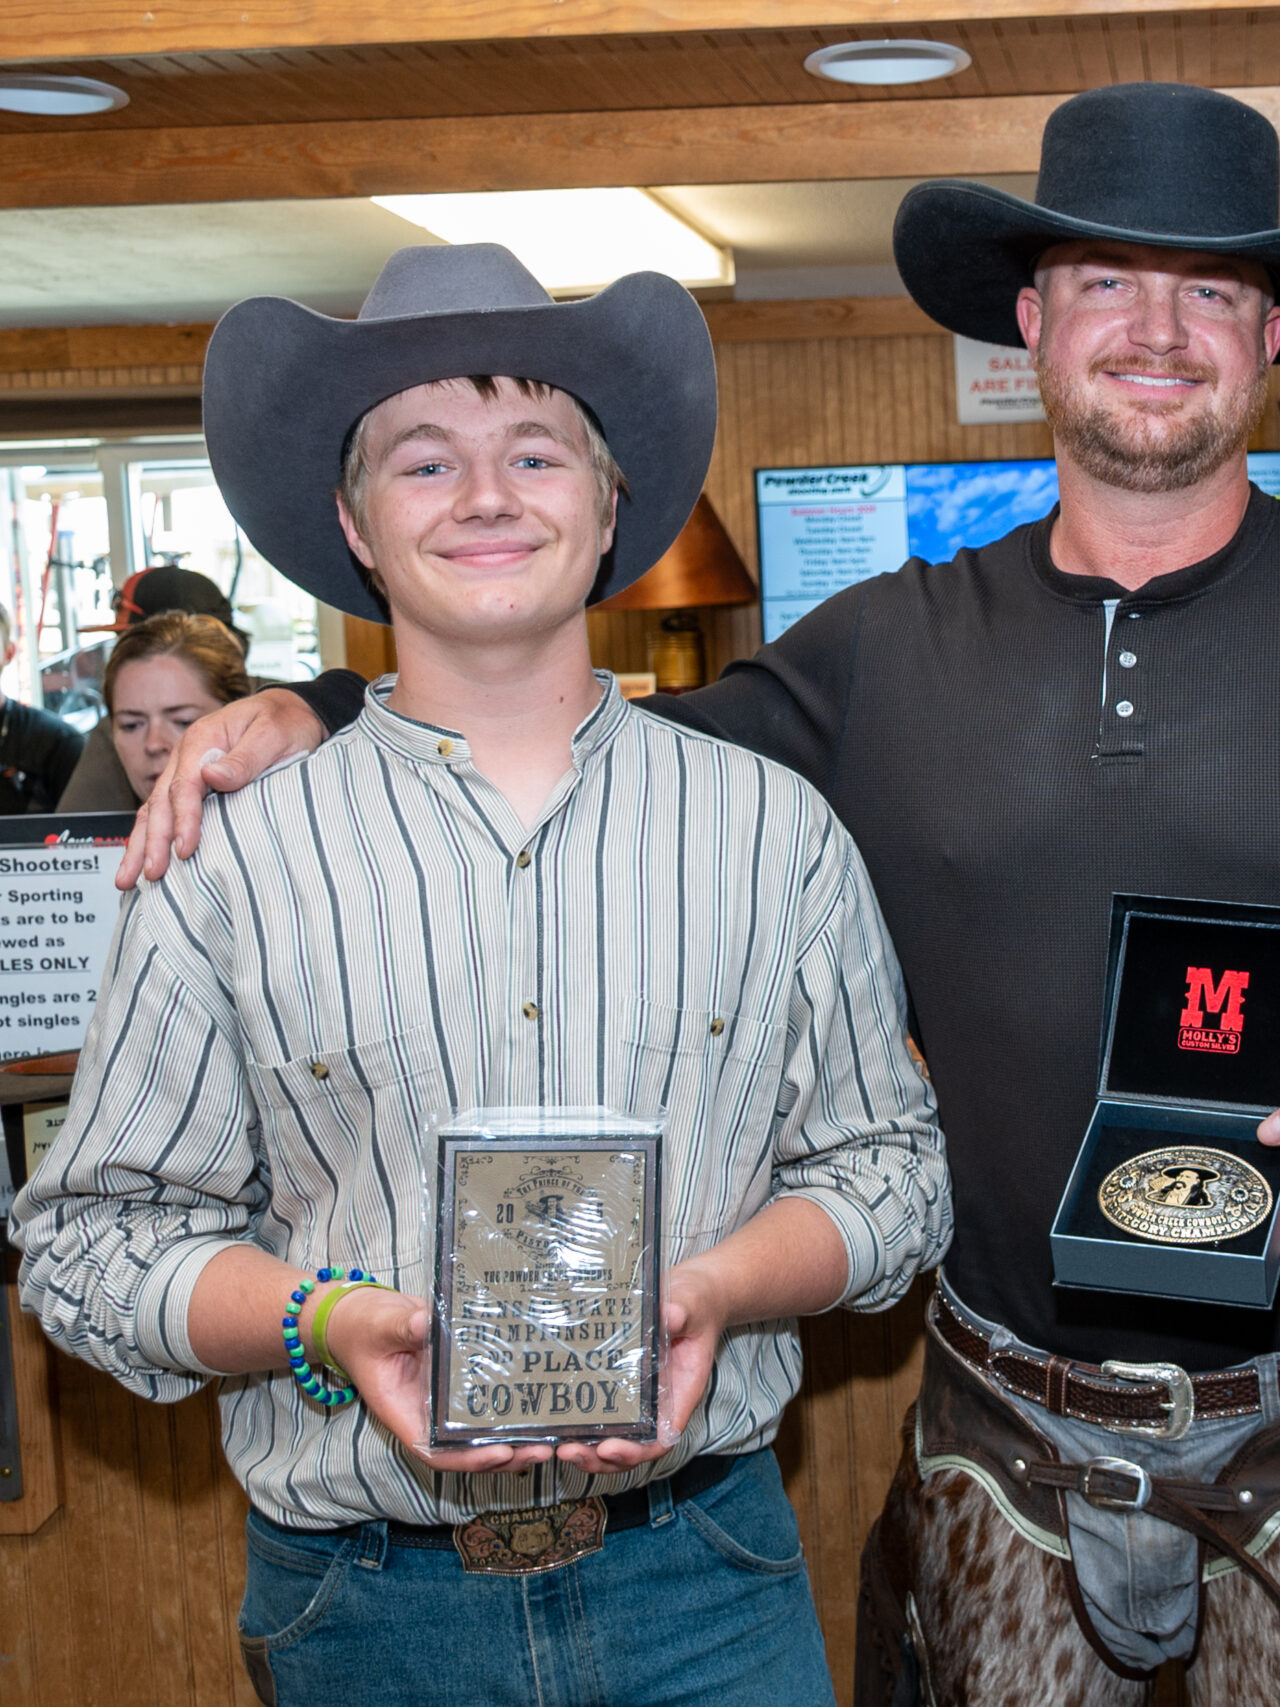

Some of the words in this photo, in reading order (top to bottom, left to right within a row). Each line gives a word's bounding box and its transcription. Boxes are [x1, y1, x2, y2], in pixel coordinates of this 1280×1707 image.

[970, 378, 1009, 394] ARE
[0, 855, 99, 873] Shooters!
[8, 889, 84, 905] Sporting
[16, 915, 45, 925] are
[51, 912, 69, 924] to
[74, 911, 96, 923] be
[45, 936, 65, 947] as
[40, 956, 90, 970] ONLY
[53, 993, 81, 1003] are
[87, 989, 97, 1002] 2
[1180, 966, 1250, 1032] M
[18, 1014, 80, 1030] singles
[1181, 1040, 1210, 1049] CUSTOM
[1211, 1042, 1236, 1051] SILVER
[1182, 1030, 1237, 1045] MOLLY'S
[496, 1203, 514, 1224] 20
[1157, 1215, 1184, 1227] CREEK
[1187, 1213, 1226, 1227] COWBOYS
[1170, 1215, 1250, 1238] CHAMPION
[484, 1271, 500, 1282] THE
[504, 1271, 539, 1282] POWDER
[564, 1298, 632, 1318] STATE
[523, 1350, 624, 1373] PLACE
[467, 1380, 620, 1417] COWBOY
[489, 1503, 571, 1525] CHAMPION
